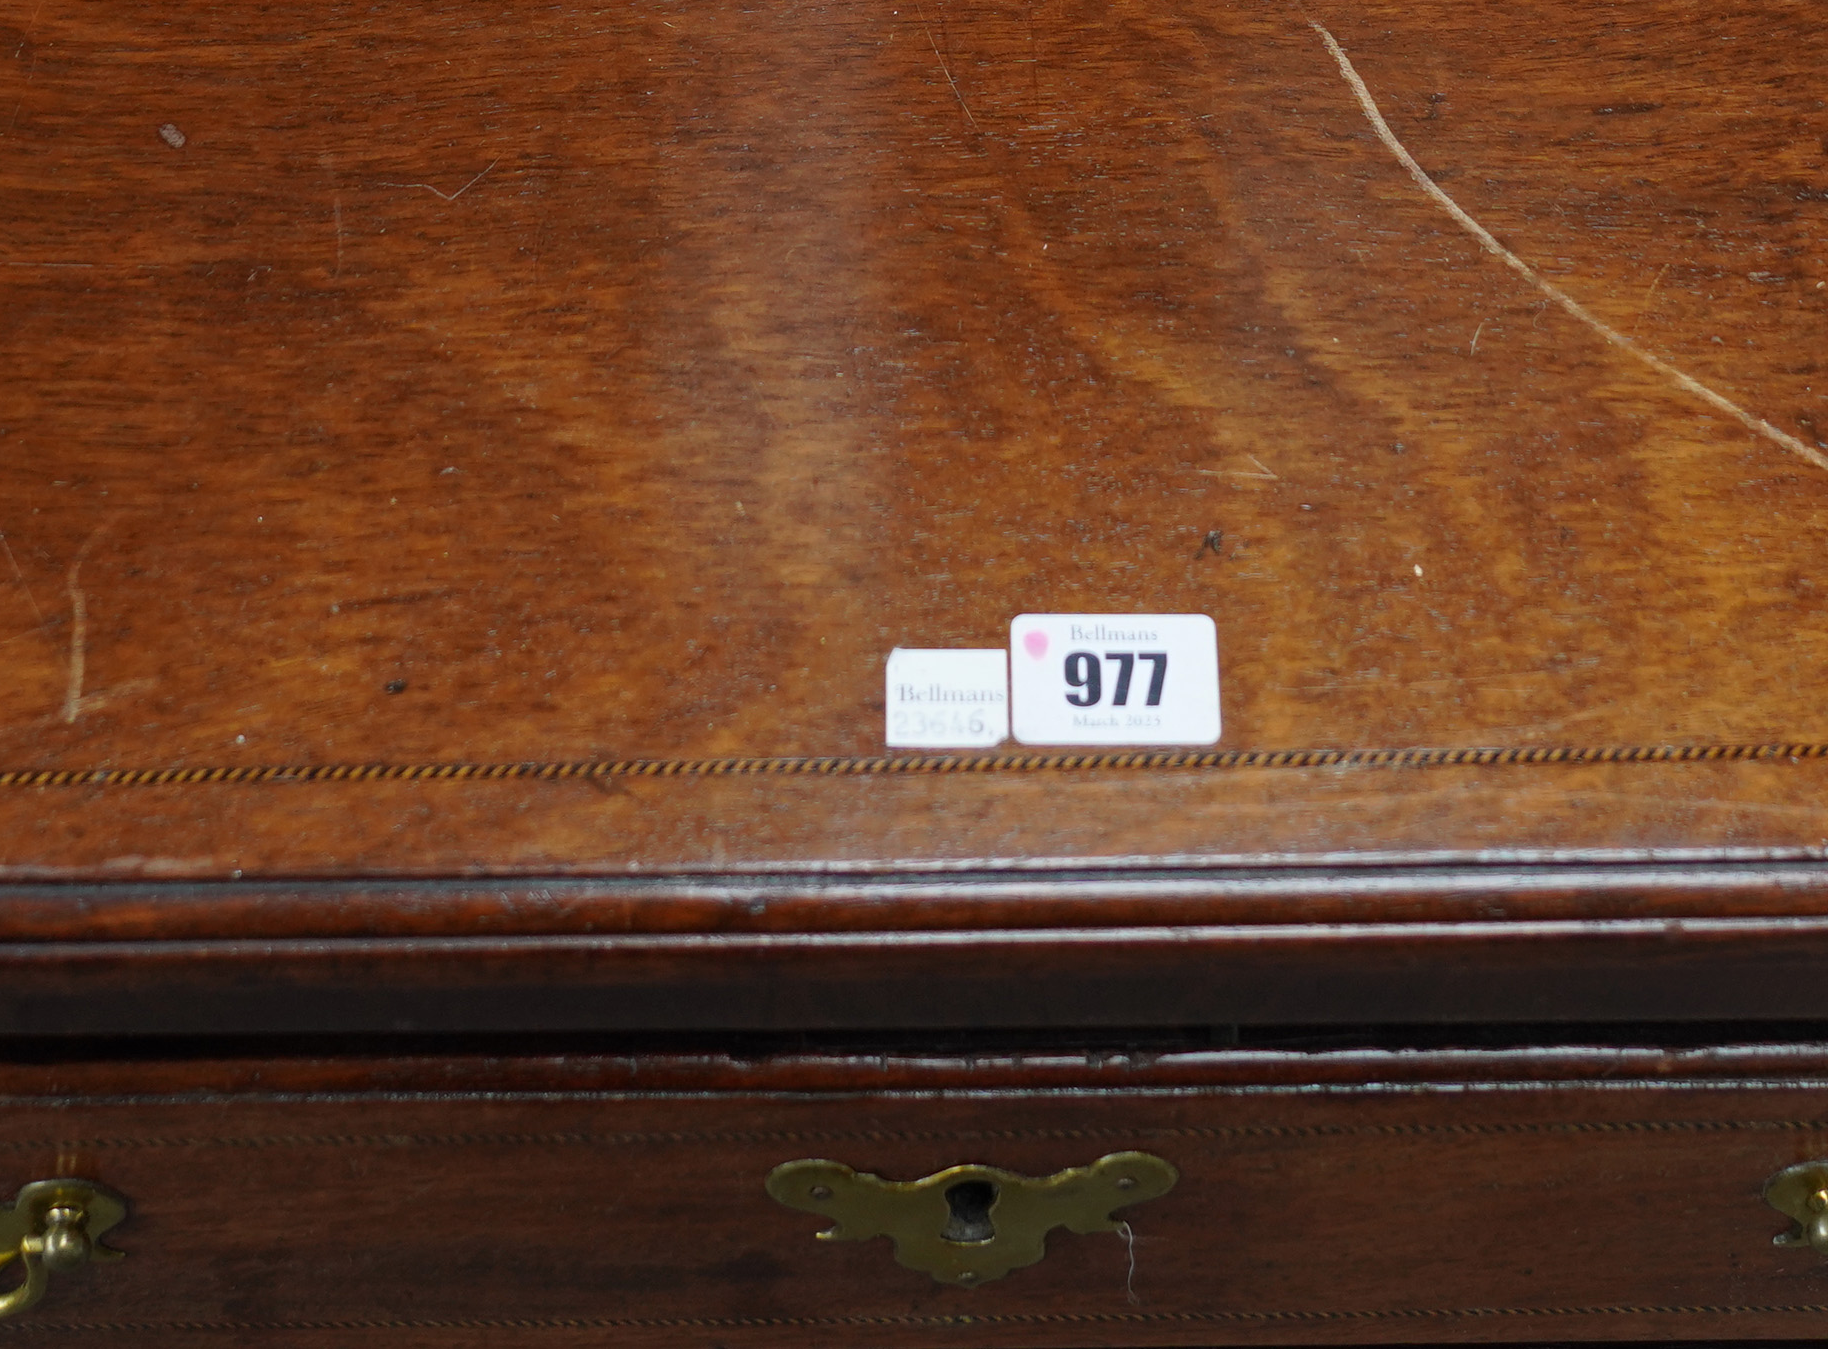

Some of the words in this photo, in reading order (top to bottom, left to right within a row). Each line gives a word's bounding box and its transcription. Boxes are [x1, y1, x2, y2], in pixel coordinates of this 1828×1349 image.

[1070, 624, 1157, 641] Bellmans
[1064, 652, 1167, 706] 977
[895, 683, 1004, 702] Bellmans
[1073, 714, 1117, 727] March
